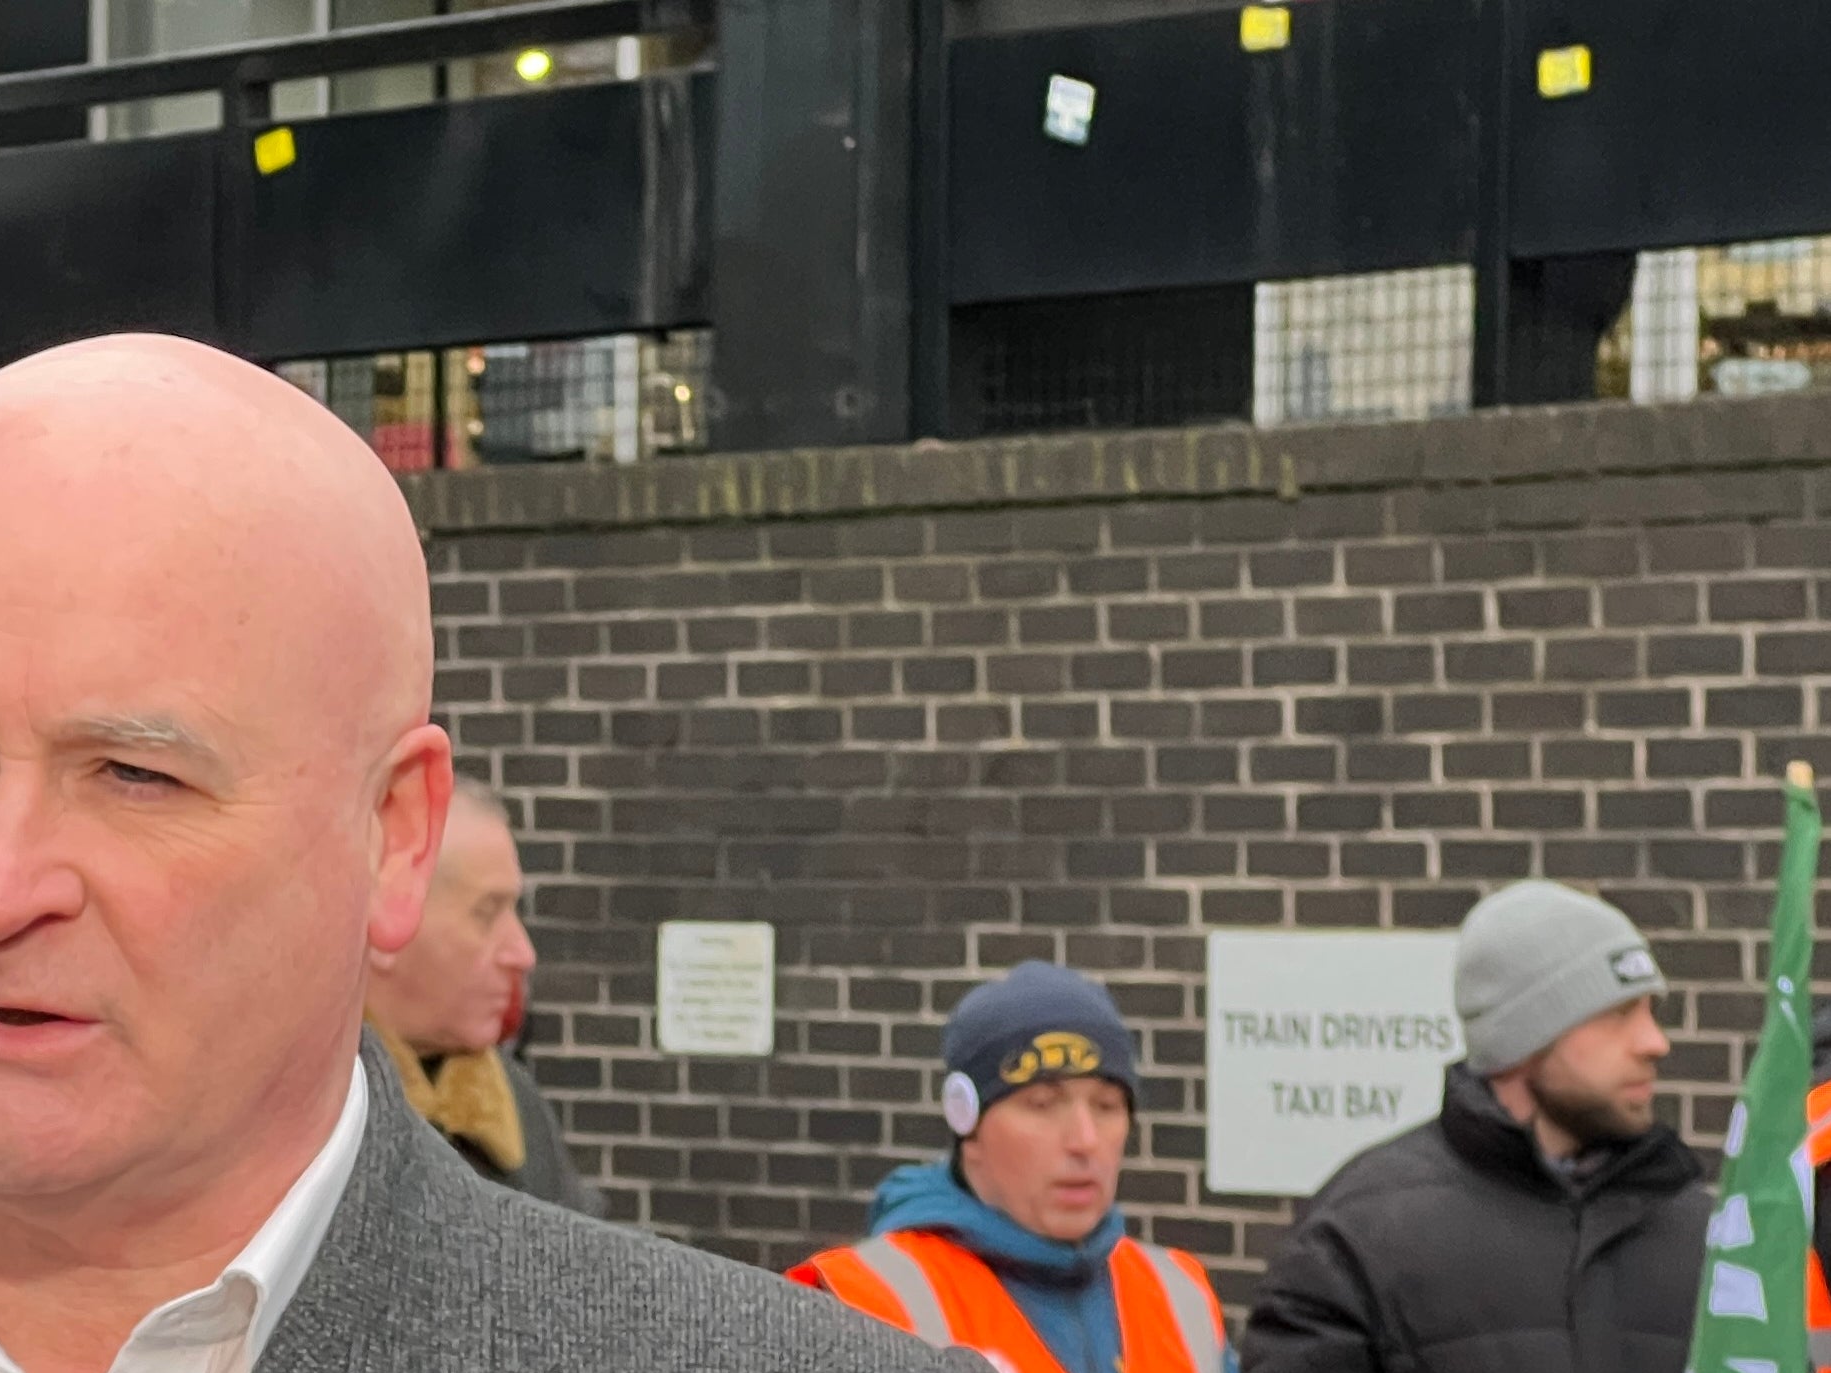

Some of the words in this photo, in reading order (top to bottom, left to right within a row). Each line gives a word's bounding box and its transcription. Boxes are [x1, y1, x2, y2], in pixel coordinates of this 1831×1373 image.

[1223, 1011, 1312, 1047] TRAIN
[1322, 1012, 1454, 1051] DRIVERS
[1271, 1079, 1336, 1118] TAXI
[1345, 1083, 1404, 1122] BAY
